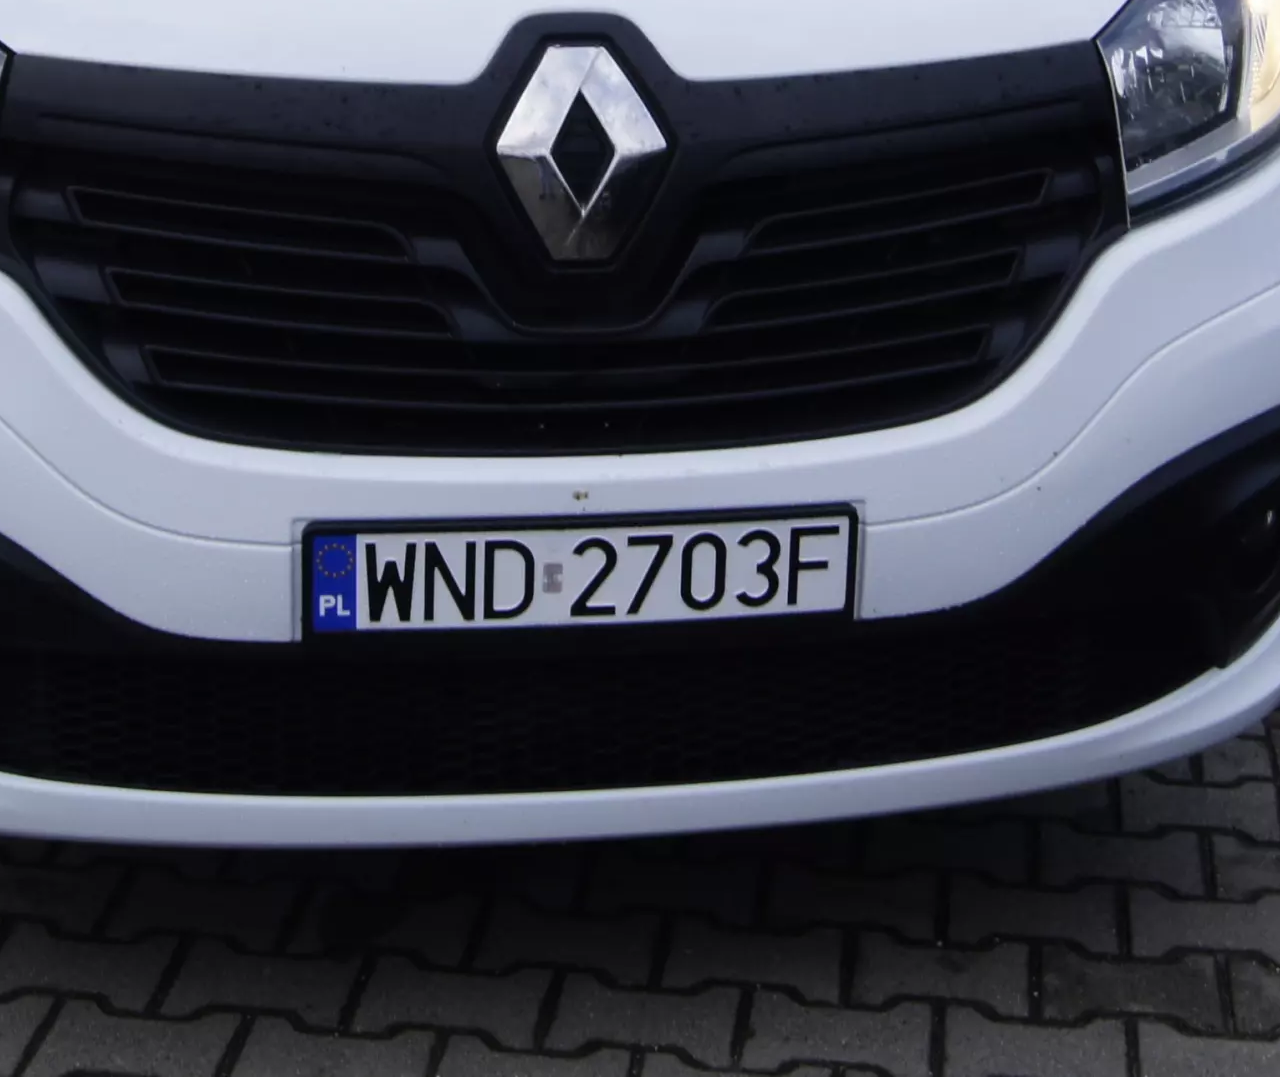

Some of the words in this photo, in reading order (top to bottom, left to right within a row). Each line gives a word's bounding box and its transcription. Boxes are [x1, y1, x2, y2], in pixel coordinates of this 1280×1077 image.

[365, 539, 535, 623] WND
[570, 525, 840, 618] 2703F
[319, 595, 351, 618] PL
